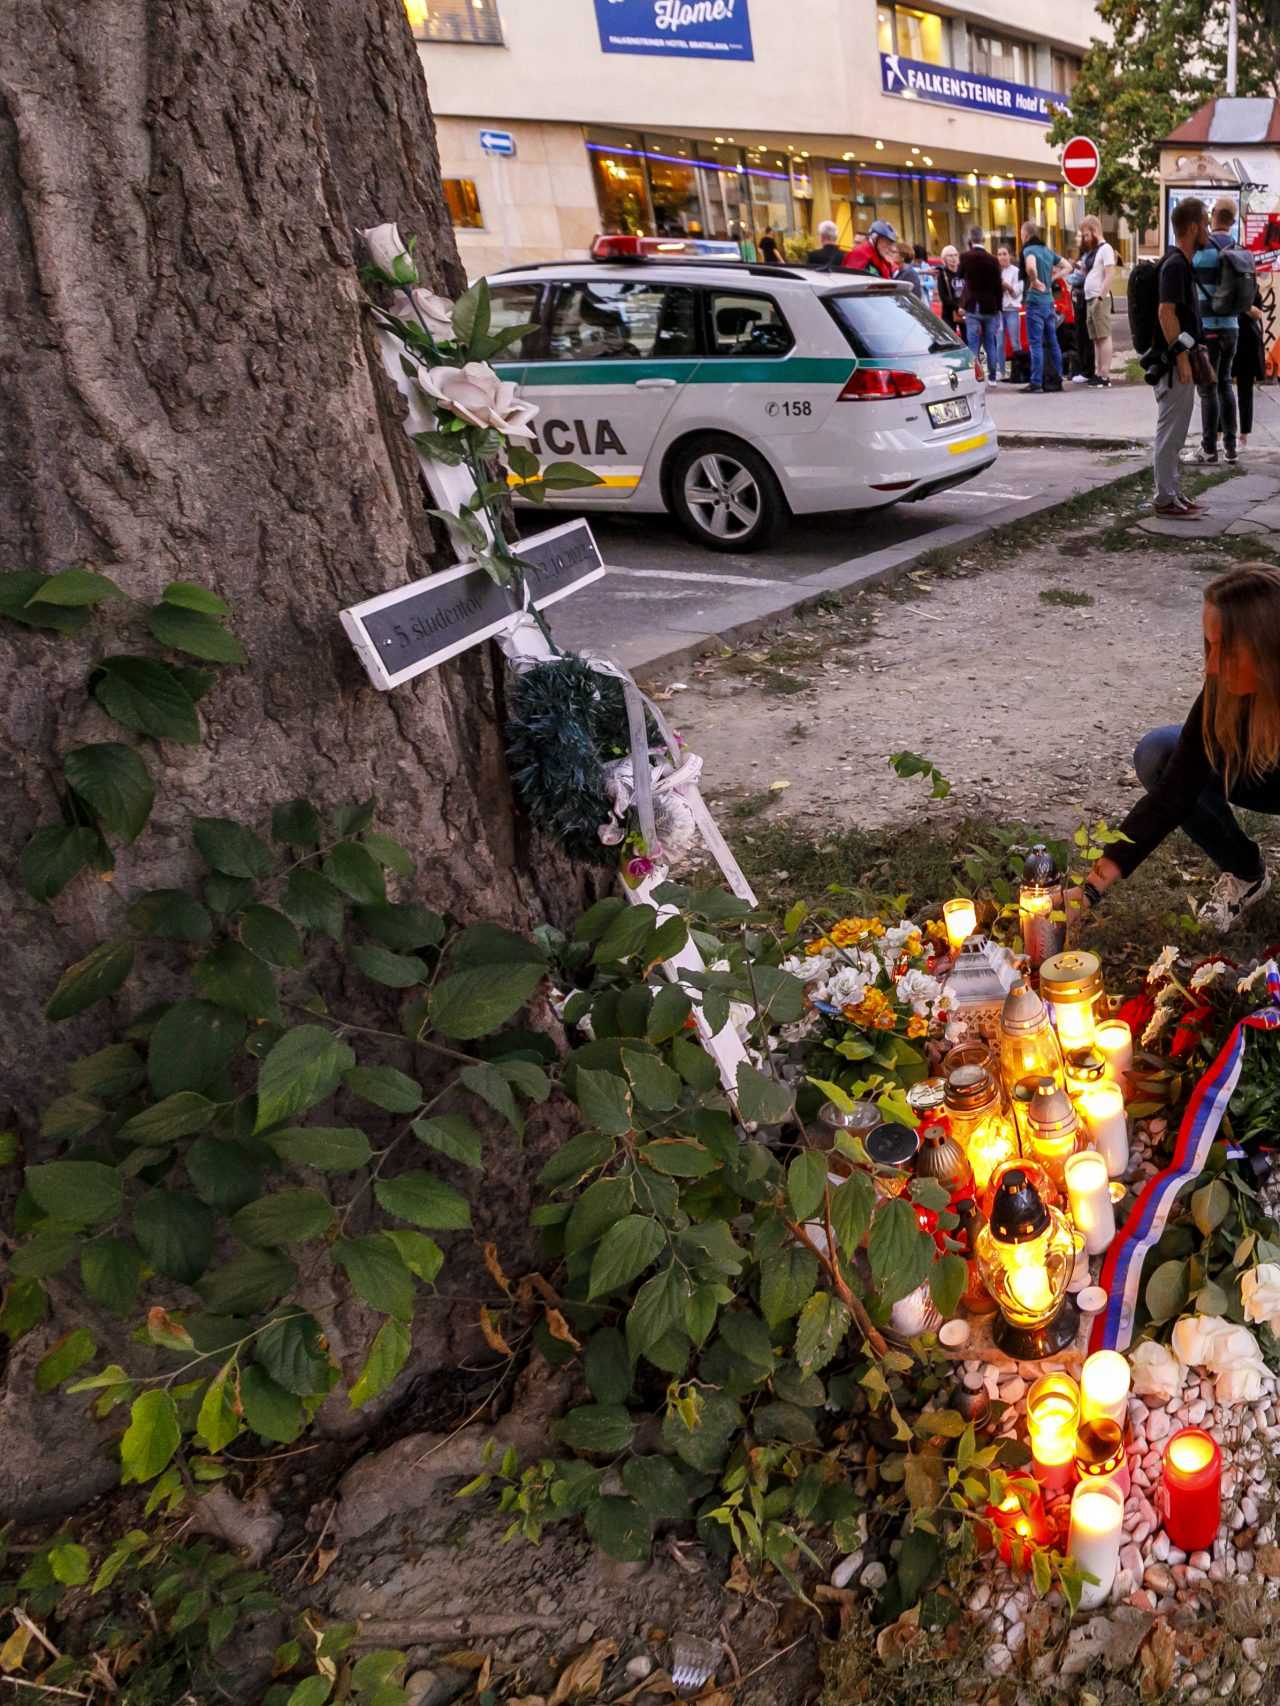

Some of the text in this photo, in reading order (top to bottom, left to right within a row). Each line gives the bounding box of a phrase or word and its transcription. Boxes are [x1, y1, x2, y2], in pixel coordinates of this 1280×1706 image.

[654, 0, 734, 32] Home!
[907, 69, 1012, 108] FALKENSTEINER
[1015, 93, 1038, 113] Hotel
[782, 400, 812, 417] 158
[393, 624, 410, 648] 5
